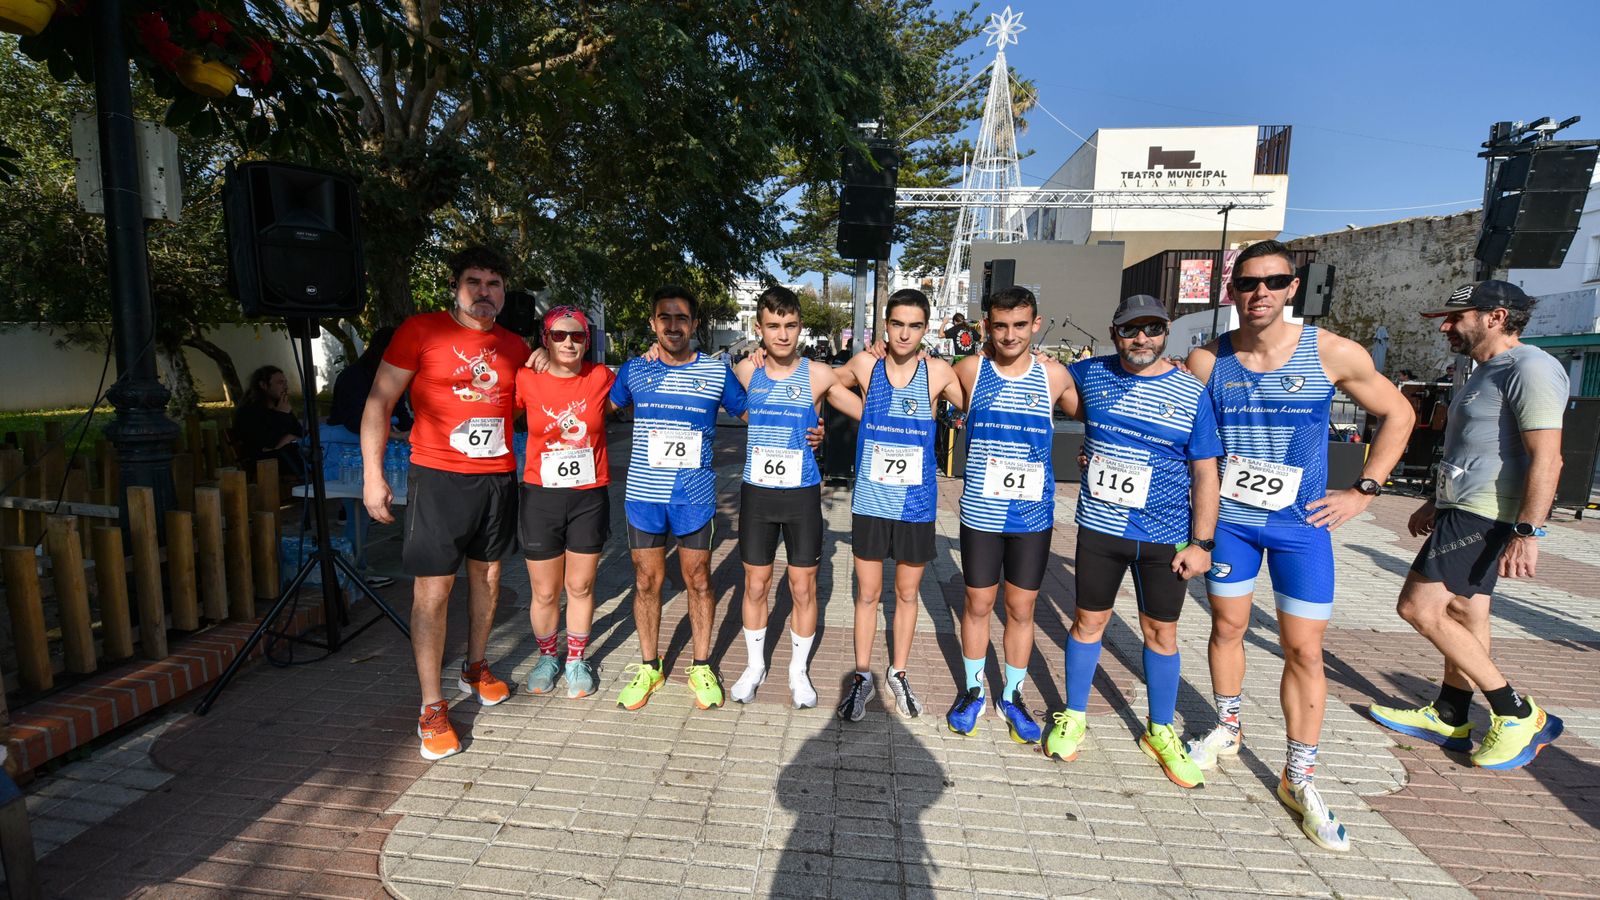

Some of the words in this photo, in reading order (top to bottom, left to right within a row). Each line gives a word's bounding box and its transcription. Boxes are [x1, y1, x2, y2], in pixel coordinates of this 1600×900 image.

[1121, 171, 1163, 179] TEATRO
[1167, 170, 1228, 178] MUNICIPAL
[1120, 179, 1226, 188] ALAMEDA
[1238, 405, 1278, 414] Atletismo
[1280, 405, 1313, 414] Linense
[876, 424, 905, 434] Atletismo
[905, 427, 928, 436] Linense
[985, 423, 1022, 431] ATLETISMO
[1100, 424, 1142, 437] ATLETISMO
[1143, 434, 1175, 446] LINENSE
[468, 429, 493, 446] 67
[663, 441, 686, 457] 78
[557, 460, 581, 477] 68
[764, 459, 786, 476] 66
[884, 458, 907, 475] 79
[1105, 459, 1117, 467] SAN
[1117, 462, 1149, 472] SILVESTRE
[1247, 458, 1262, 467] SAN
[1263, 462, 1298, 474] SILVESTRE
[1003, 472, 1026, 489] 61
[1096, 469, 1134, 494] 116
[1236, 470, 1284, 496] 229
